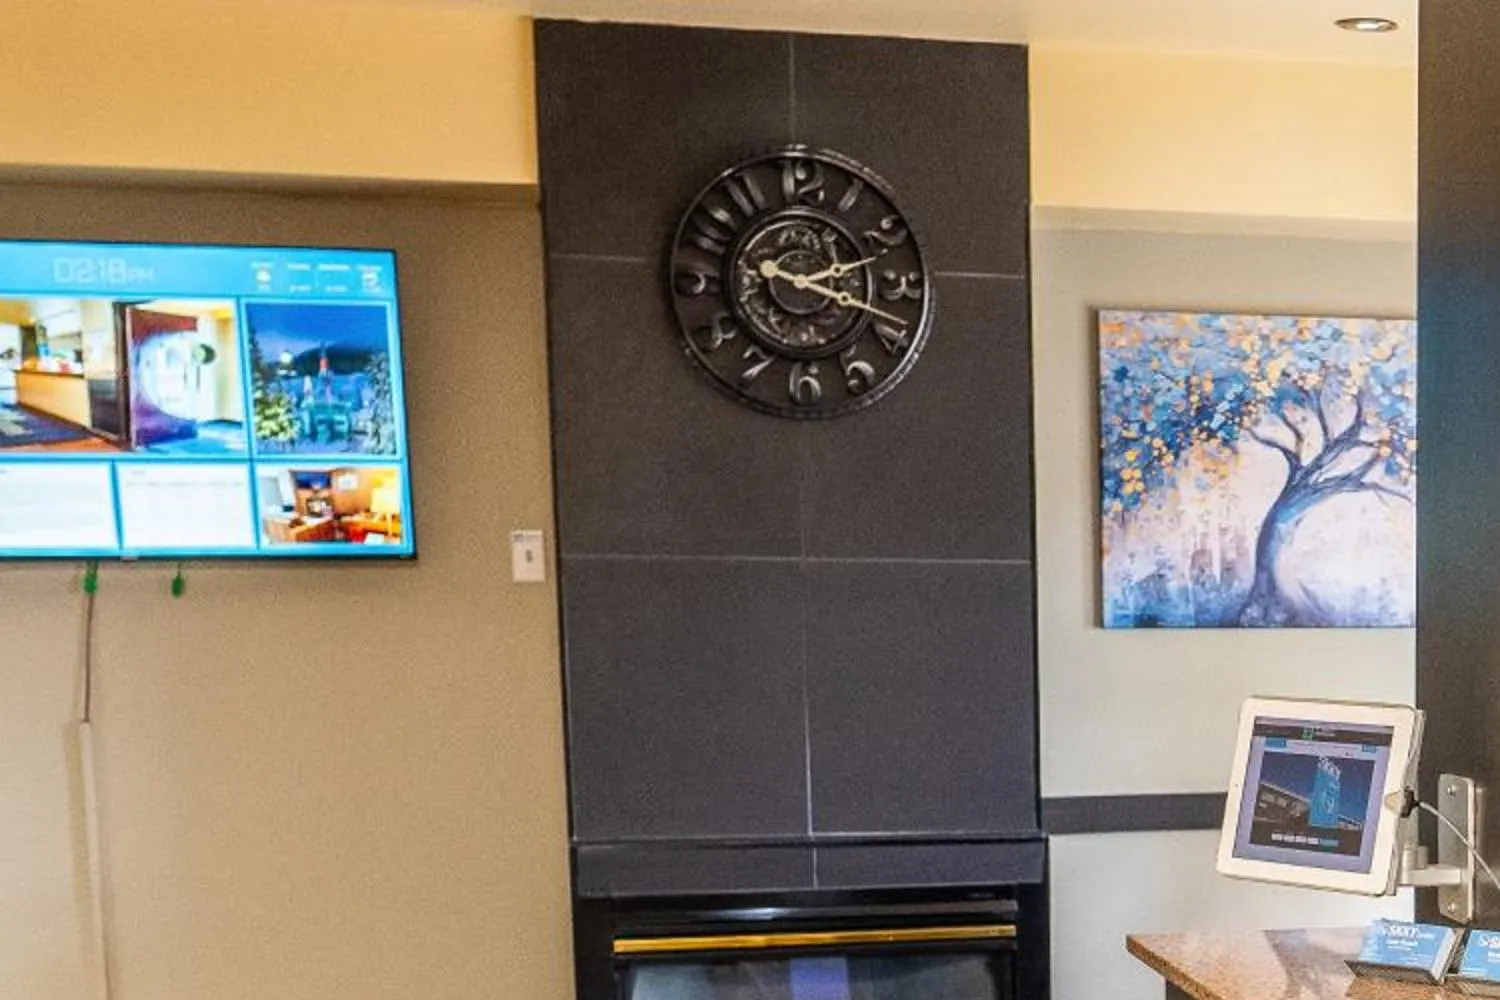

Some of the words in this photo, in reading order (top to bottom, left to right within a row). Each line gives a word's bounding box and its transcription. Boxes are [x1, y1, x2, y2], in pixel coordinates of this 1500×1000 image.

[780, 160, 825, 203] 12
[836, 177, 865, 213] 1
[863, 213, 909, 256] 2
[879, 268, 922, 301] 3
[873, 322, 911, 356] 4
[740, 344, 777, 381] 7
[840, 343, 878, 395] 5
[788, 361, 823, 406] 6
